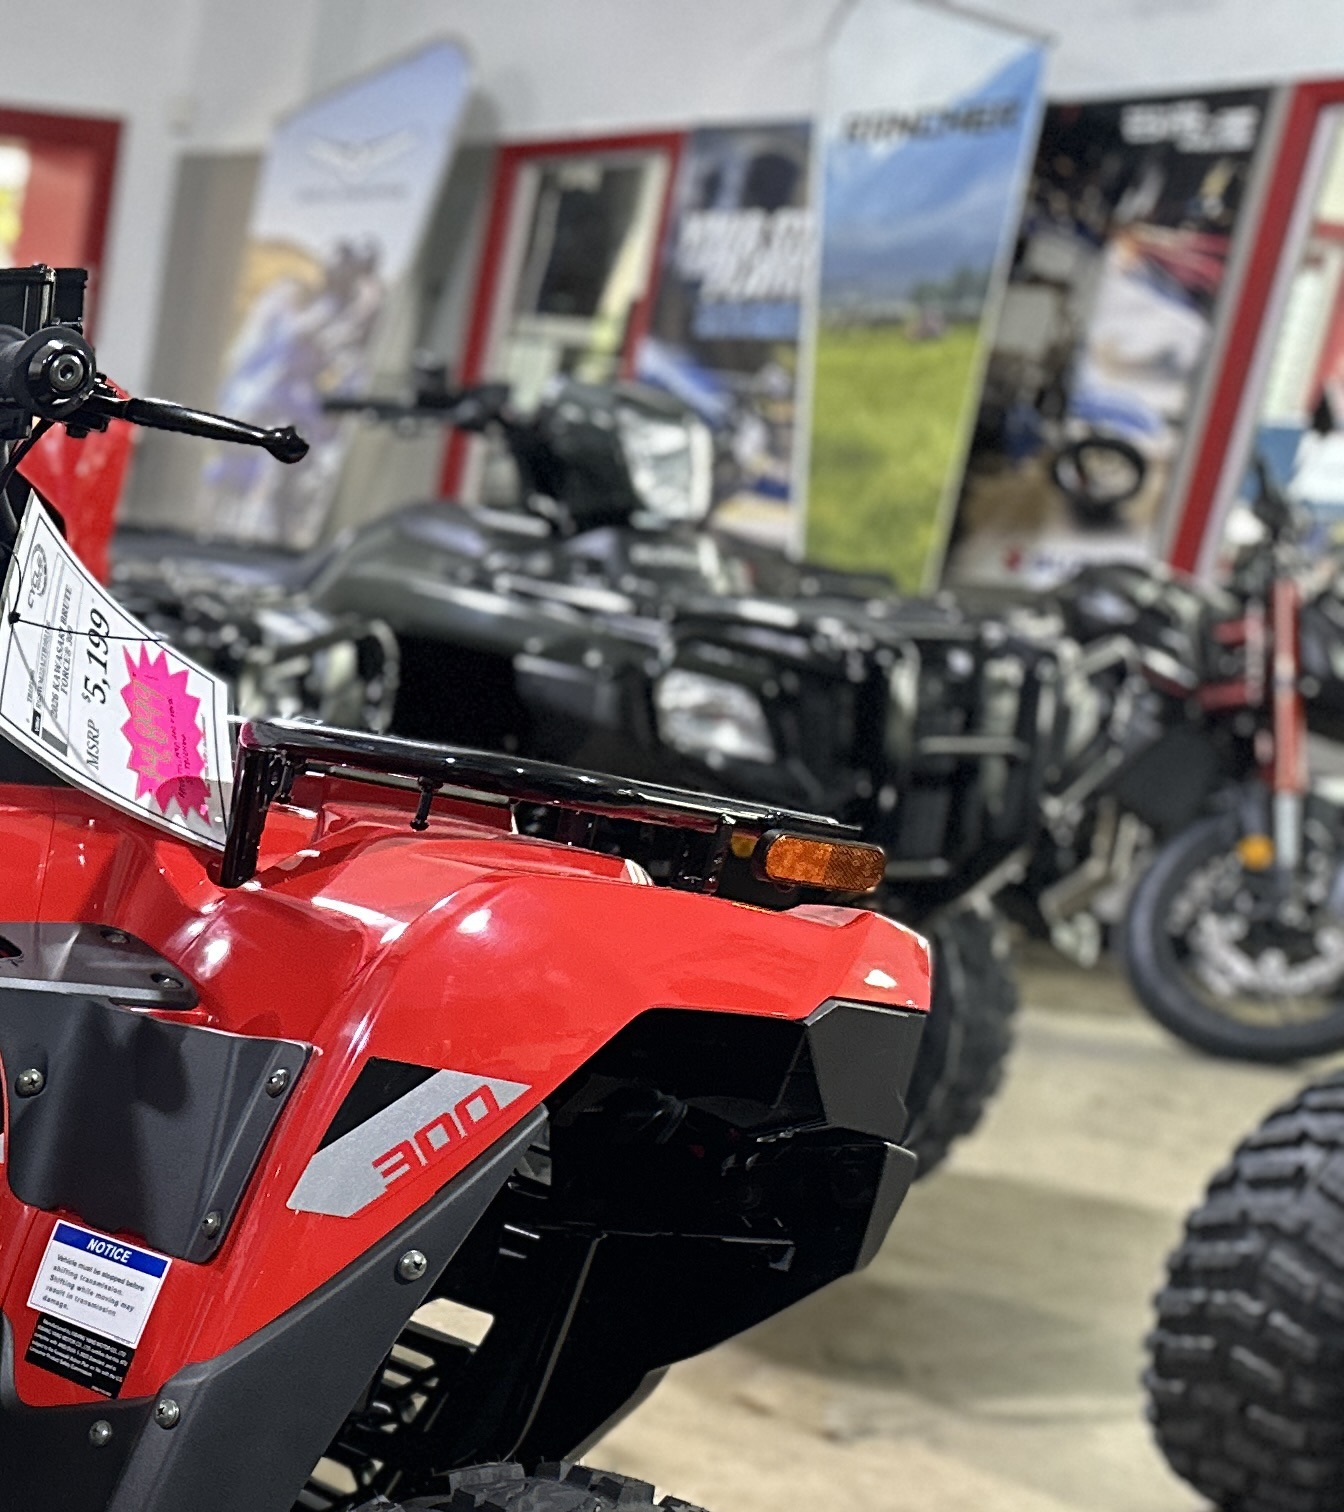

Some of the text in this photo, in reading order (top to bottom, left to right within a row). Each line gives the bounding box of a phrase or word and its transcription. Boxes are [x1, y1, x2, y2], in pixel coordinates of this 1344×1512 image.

[60, 583, 73, 624] BRUTE
[81, 607, 110, 770] MSRP $5,199
[372, 1084, 500, 1192] 300
[86, 1238, 133, 1264] NOTICE
